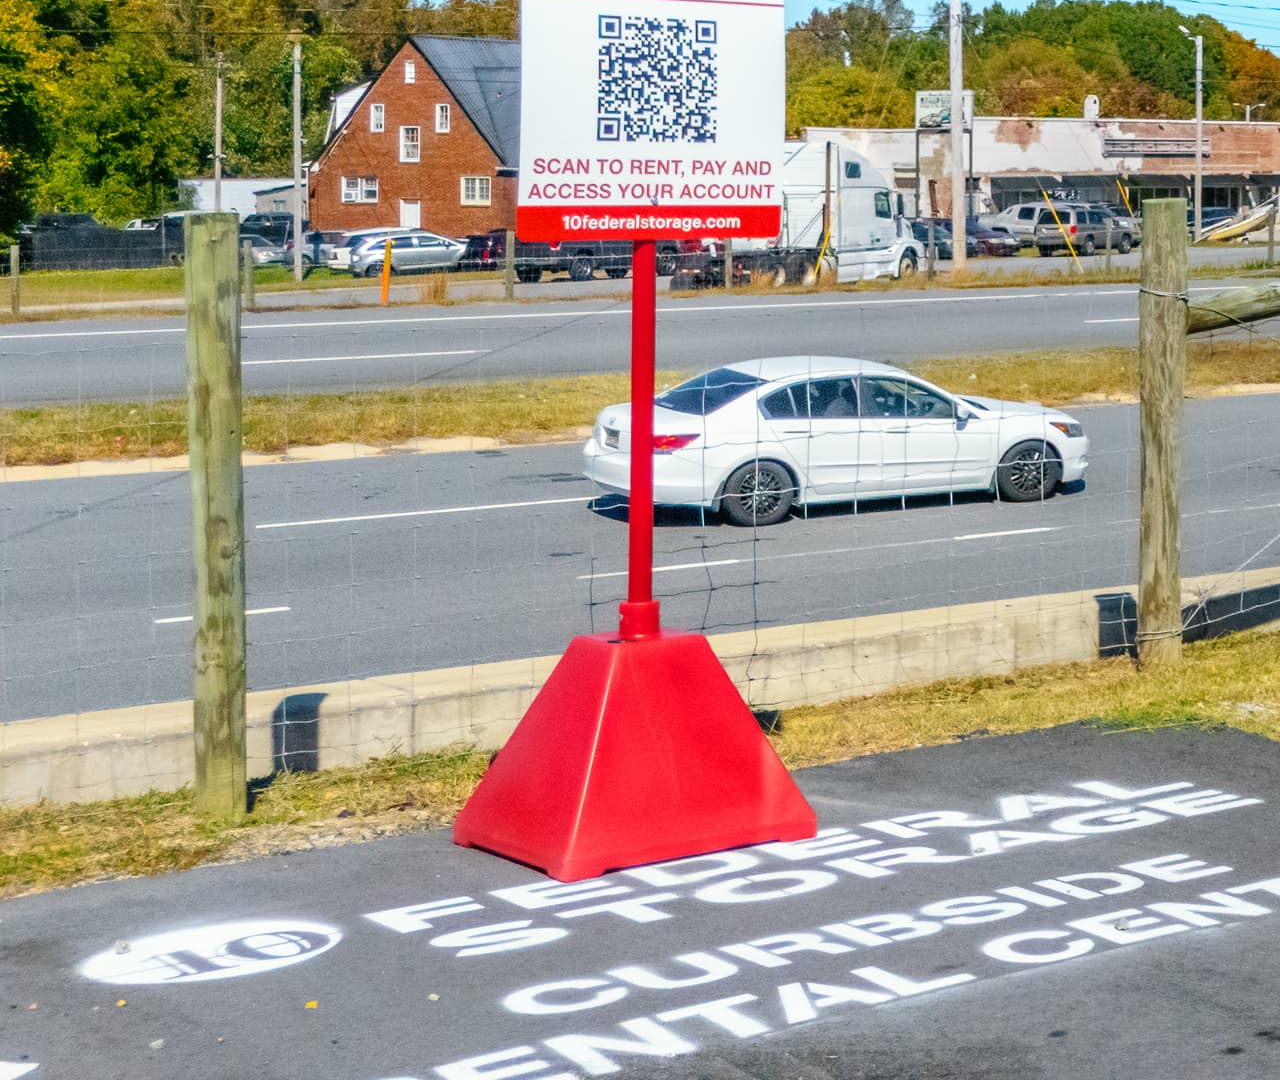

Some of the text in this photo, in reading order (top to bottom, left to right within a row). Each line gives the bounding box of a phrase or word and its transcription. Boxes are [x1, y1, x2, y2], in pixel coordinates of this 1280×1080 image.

[528, 183, 775, 200] ACCESS YOUR ACCOUNT
[533, 158, 772, 178] SCAN TO RENT, PAY AND
[562, 214, 741, 234] 10federalstorage.com
[363, 780, 1196, 934] FEDERAL
[429, 789, 1264, 957] STORAGE
[502, 853, 1233, 1015] CURBSIDE
[376, 965, 977, 1080] ENTAL
